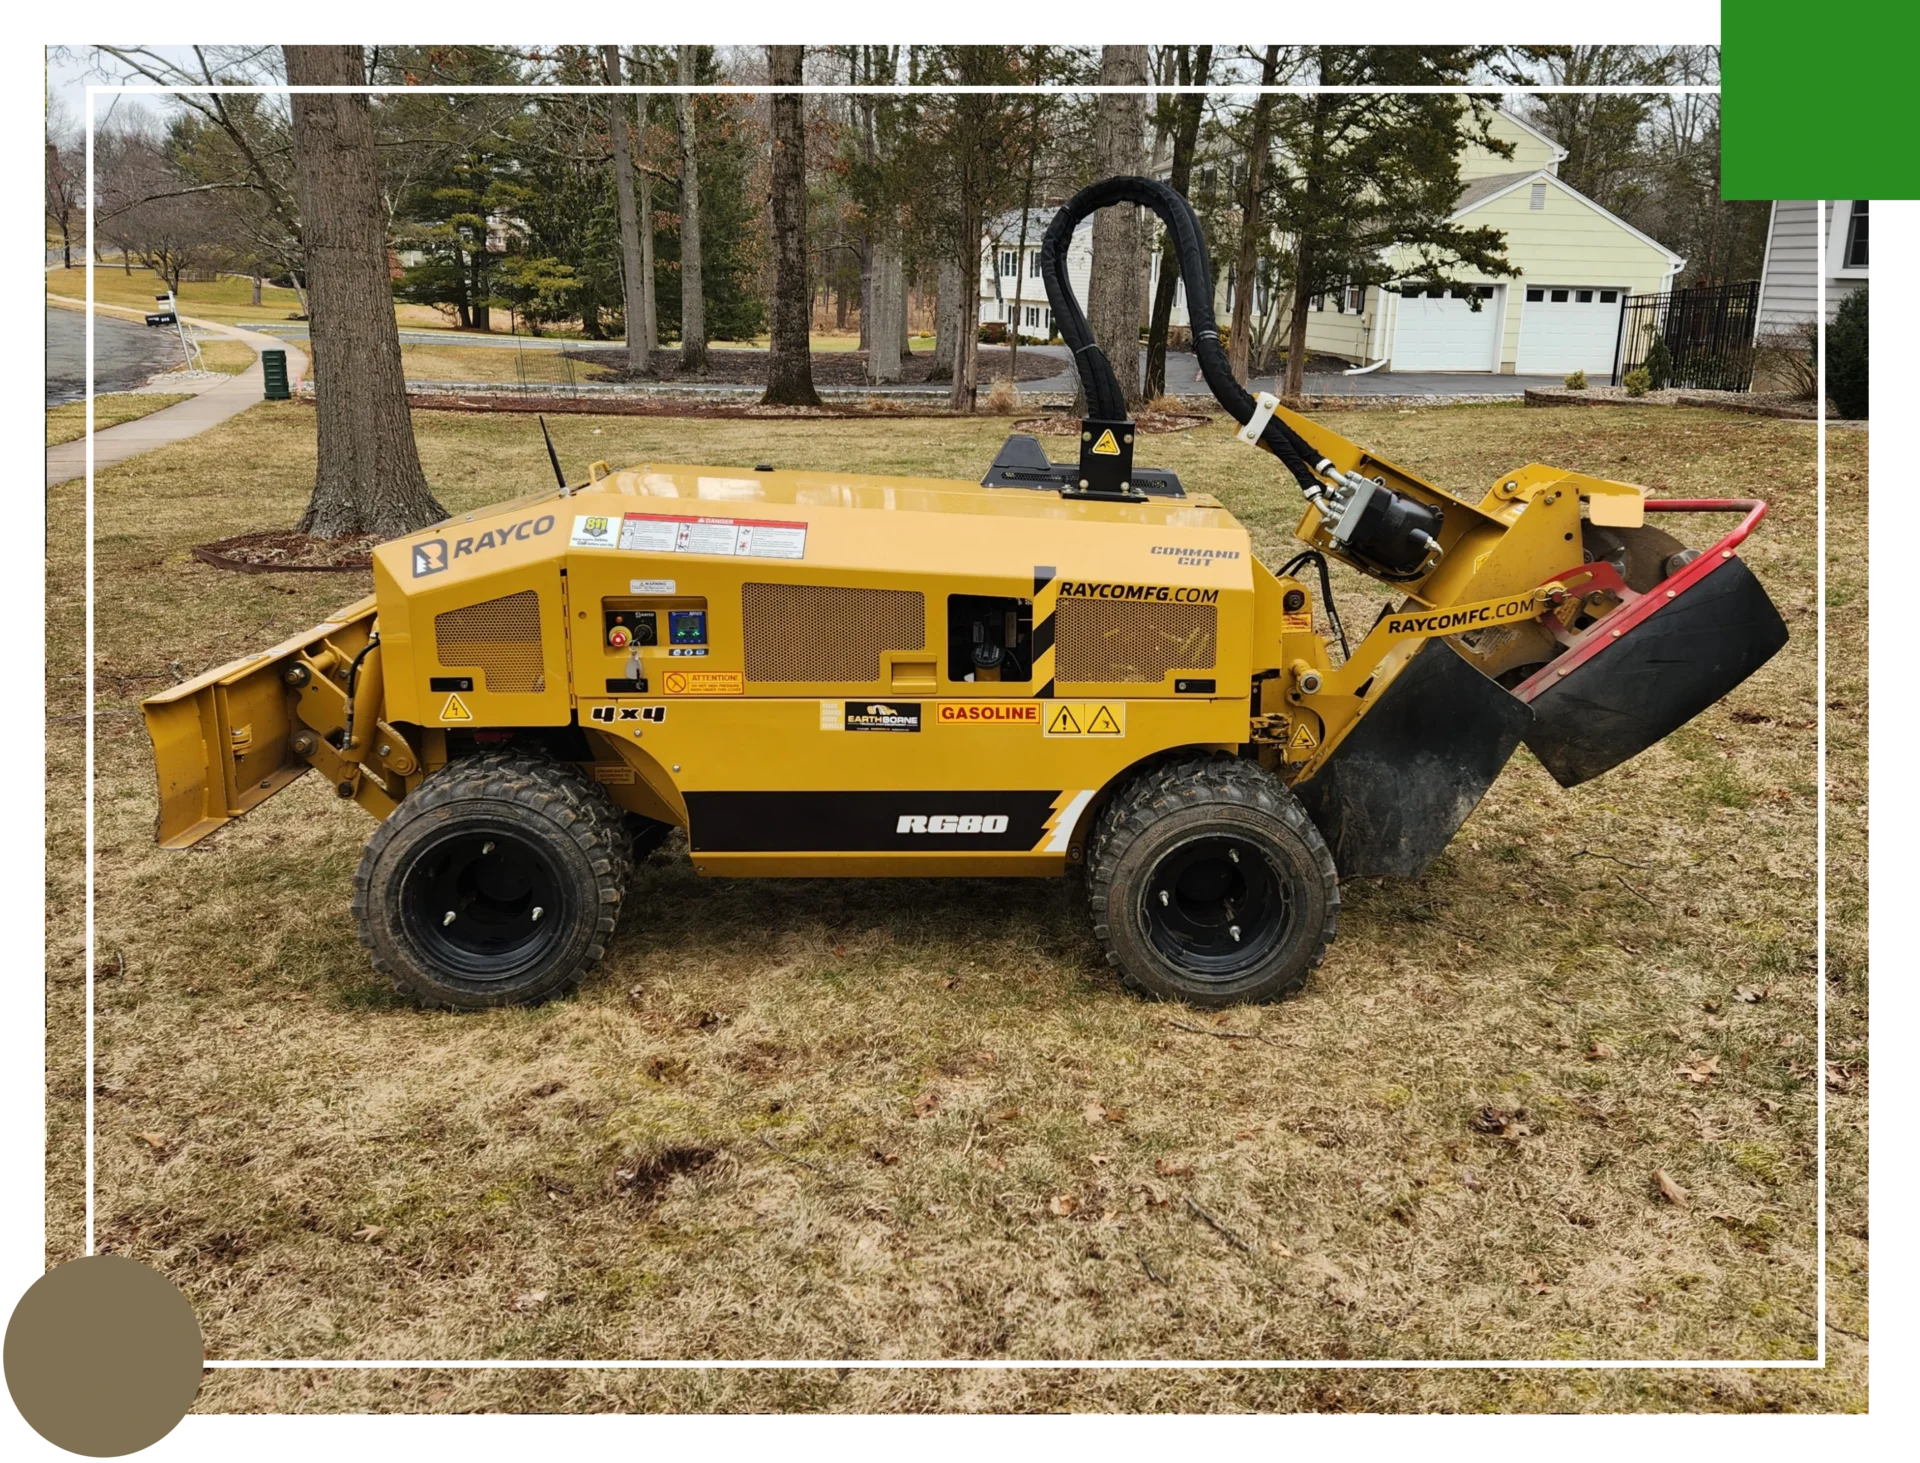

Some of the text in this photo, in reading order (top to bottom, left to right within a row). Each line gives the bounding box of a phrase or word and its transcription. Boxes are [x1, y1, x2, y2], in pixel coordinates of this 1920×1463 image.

[585, 517, 608, 530] 811
[705, 517, 734, 525] DANGER
[453, 515, 555, 559] RAYCO
[1150, 546, 1240, 559] COMMAND
[1177, 557, 1214, 567] CUT
[1059, 582, 1219, 604] RAYCOMFG.COM
[847, 715, 918, 724] EARTHBORNE
[941, 706, 1037, 720] GASOLINE
[896, 815, 1010, 833] RG80
